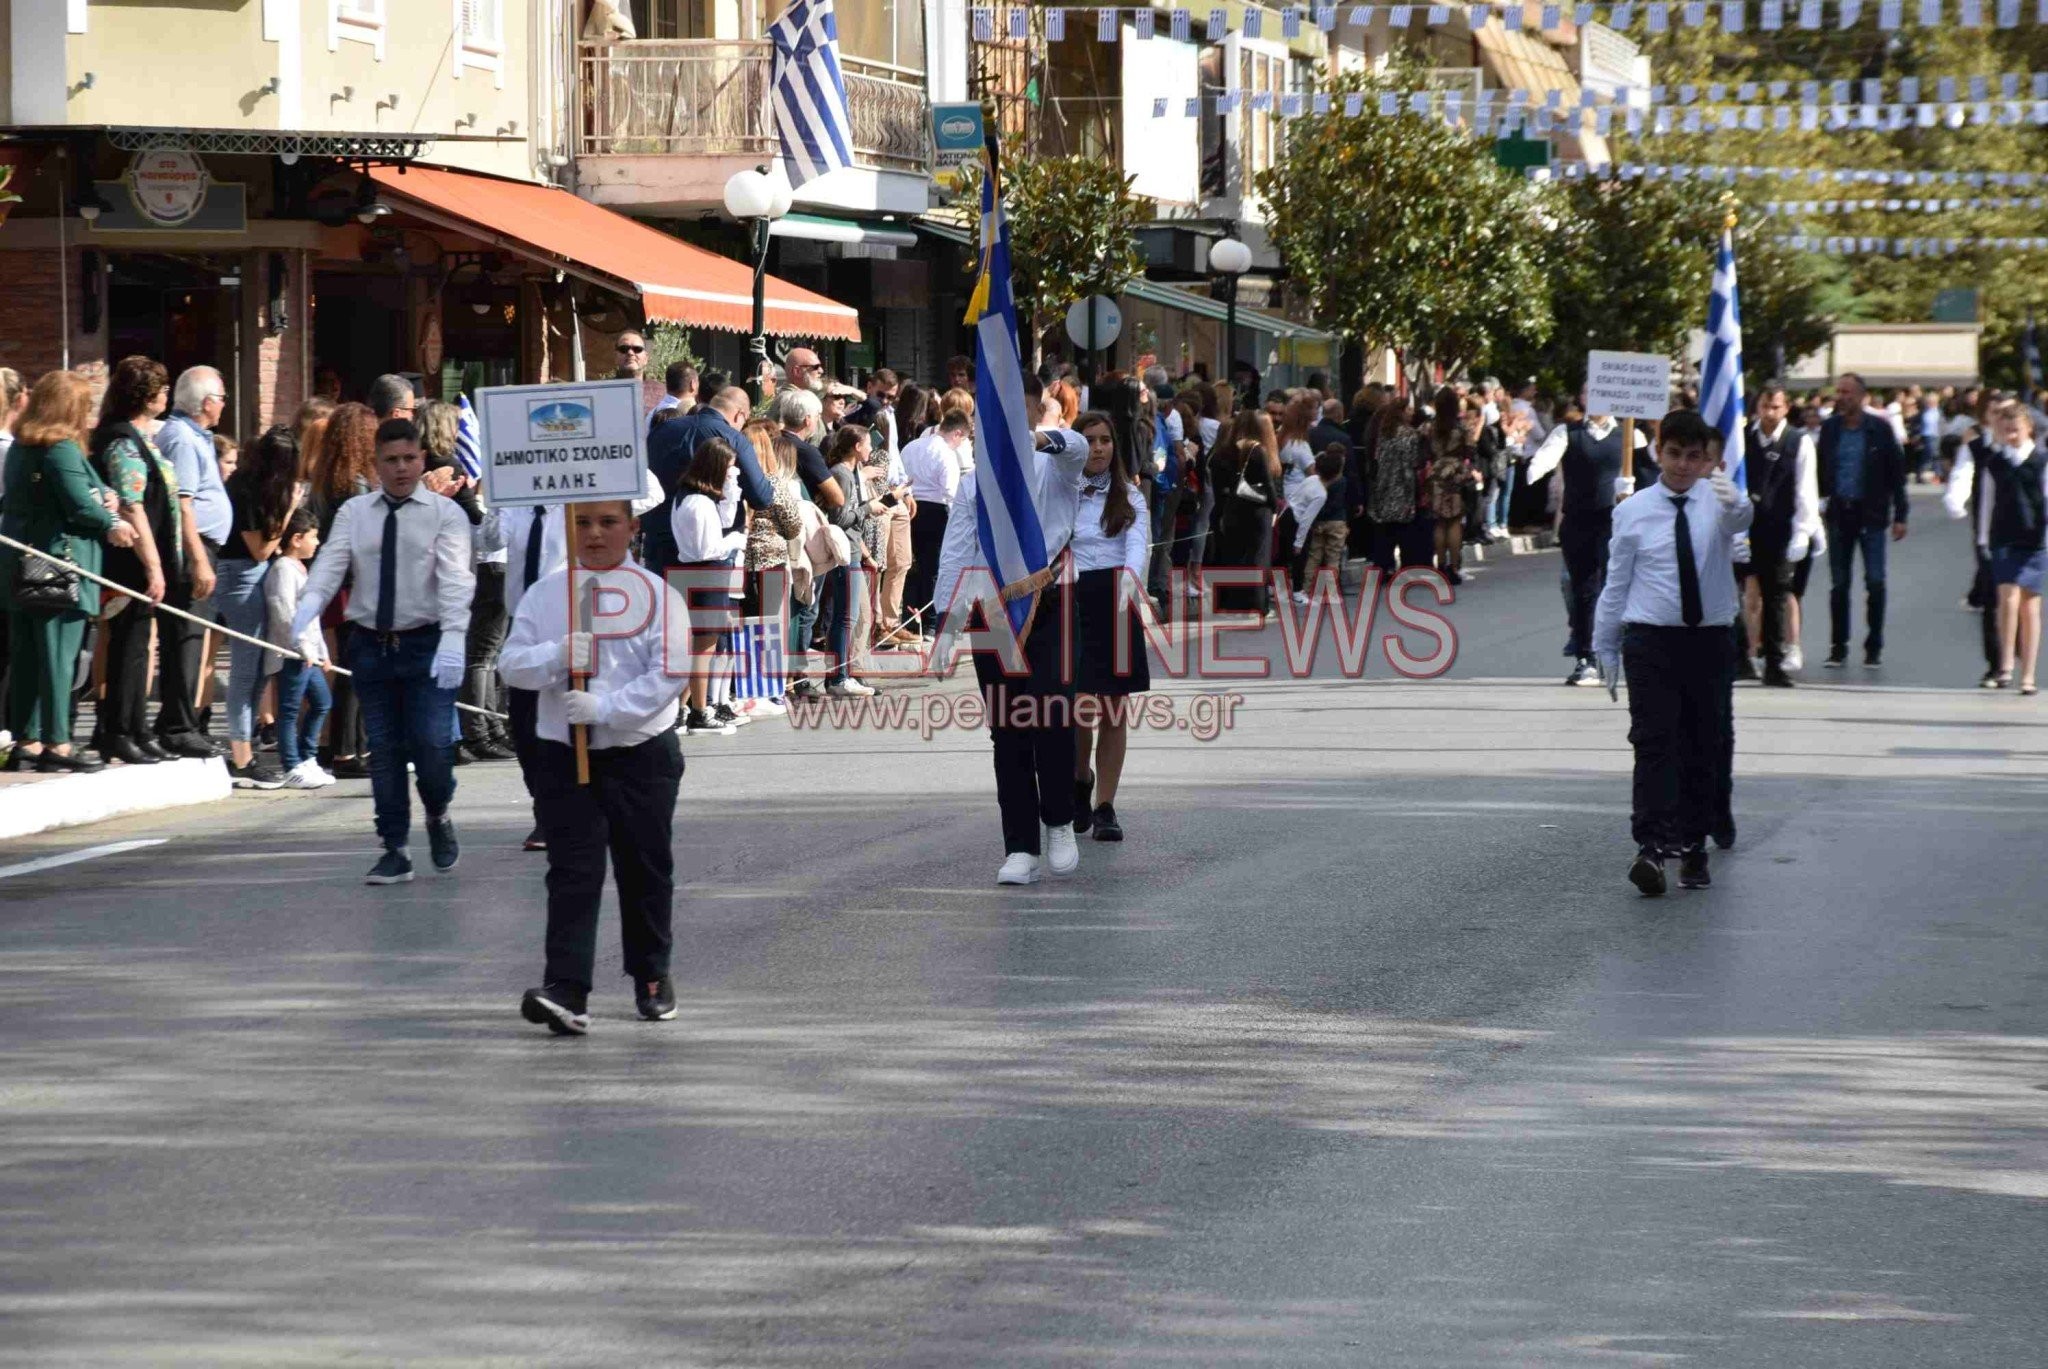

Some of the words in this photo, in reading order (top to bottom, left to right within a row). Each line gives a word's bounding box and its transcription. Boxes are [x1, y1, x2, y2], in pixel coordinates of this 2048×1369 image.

[494, 448, 569, 467] ΔΗΜΟΤΙΚΟ
[572, 444, 633, 462] ΣΧΟΛΕΙΟ
[533, 473, 597, 491] ΚΑΛΗΣ
